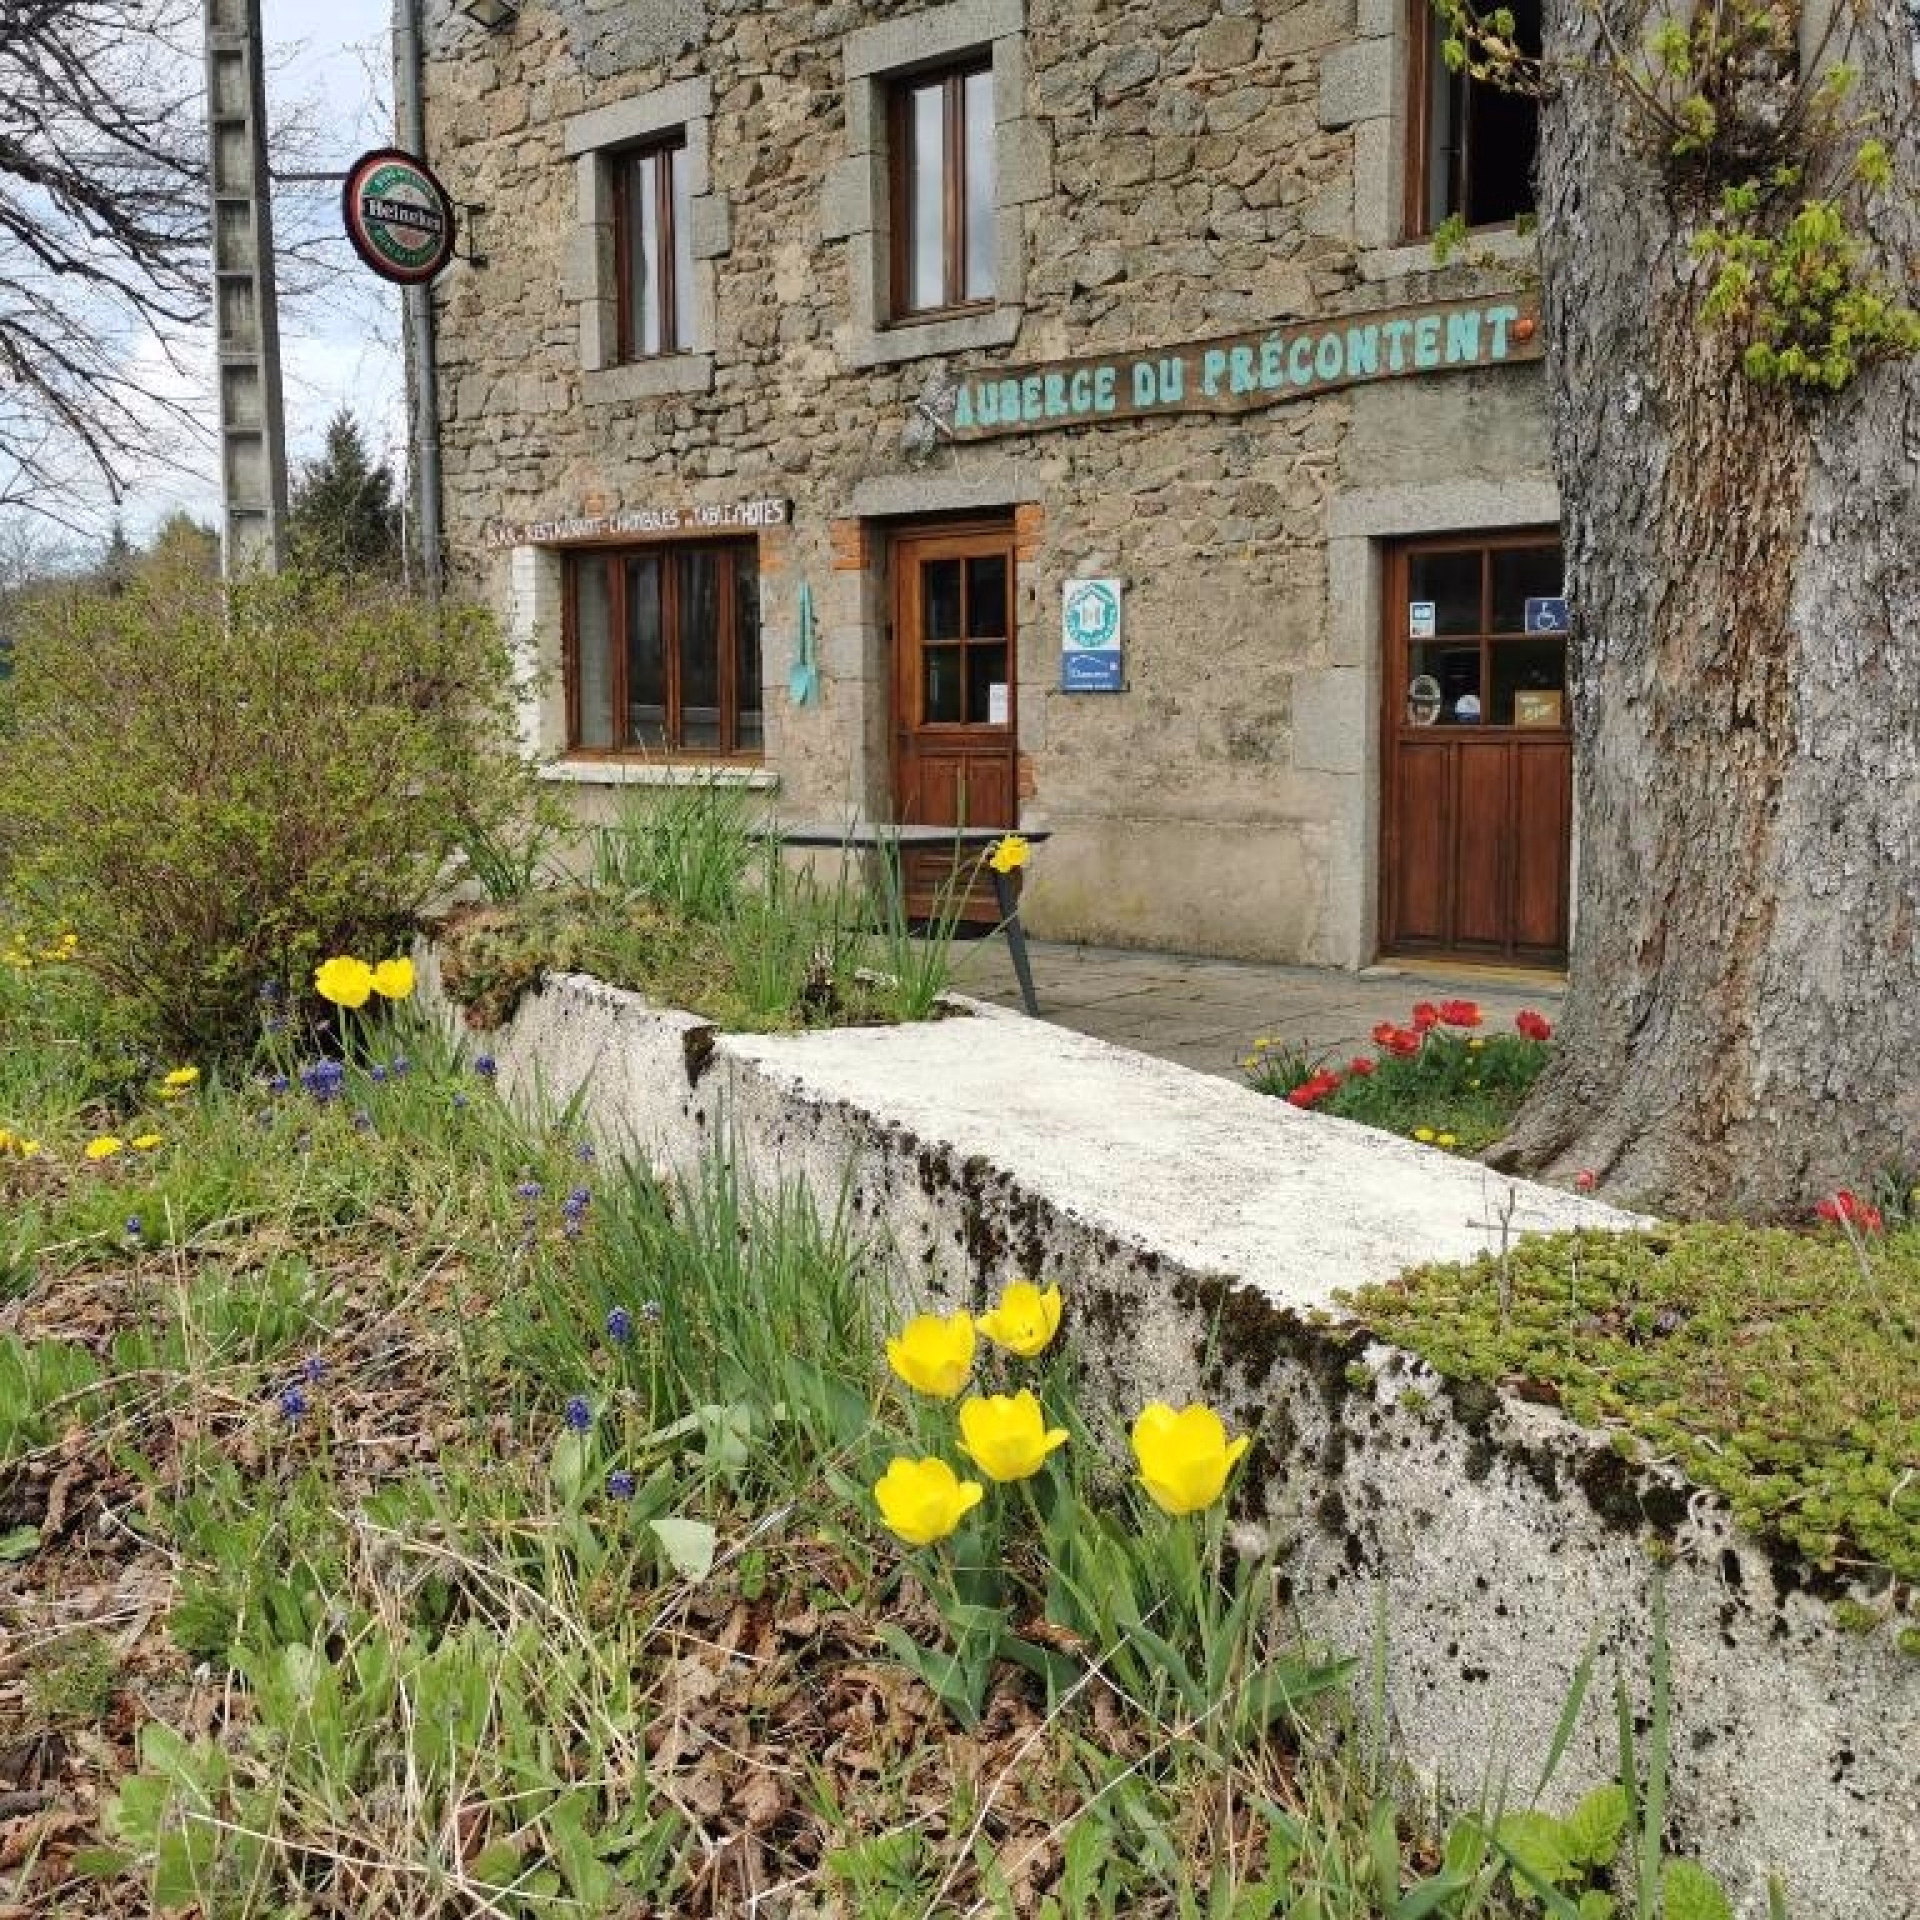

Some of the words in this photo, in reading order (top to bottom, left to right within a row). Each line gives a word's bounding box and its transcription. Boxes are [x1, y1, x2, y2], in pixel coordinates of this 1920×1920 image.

[955, 366, 1116, 428] AUBERGE
[1132, 356, 1184, 408] DU
[1203, 304, 1519, 396] PRÉCONTENT
